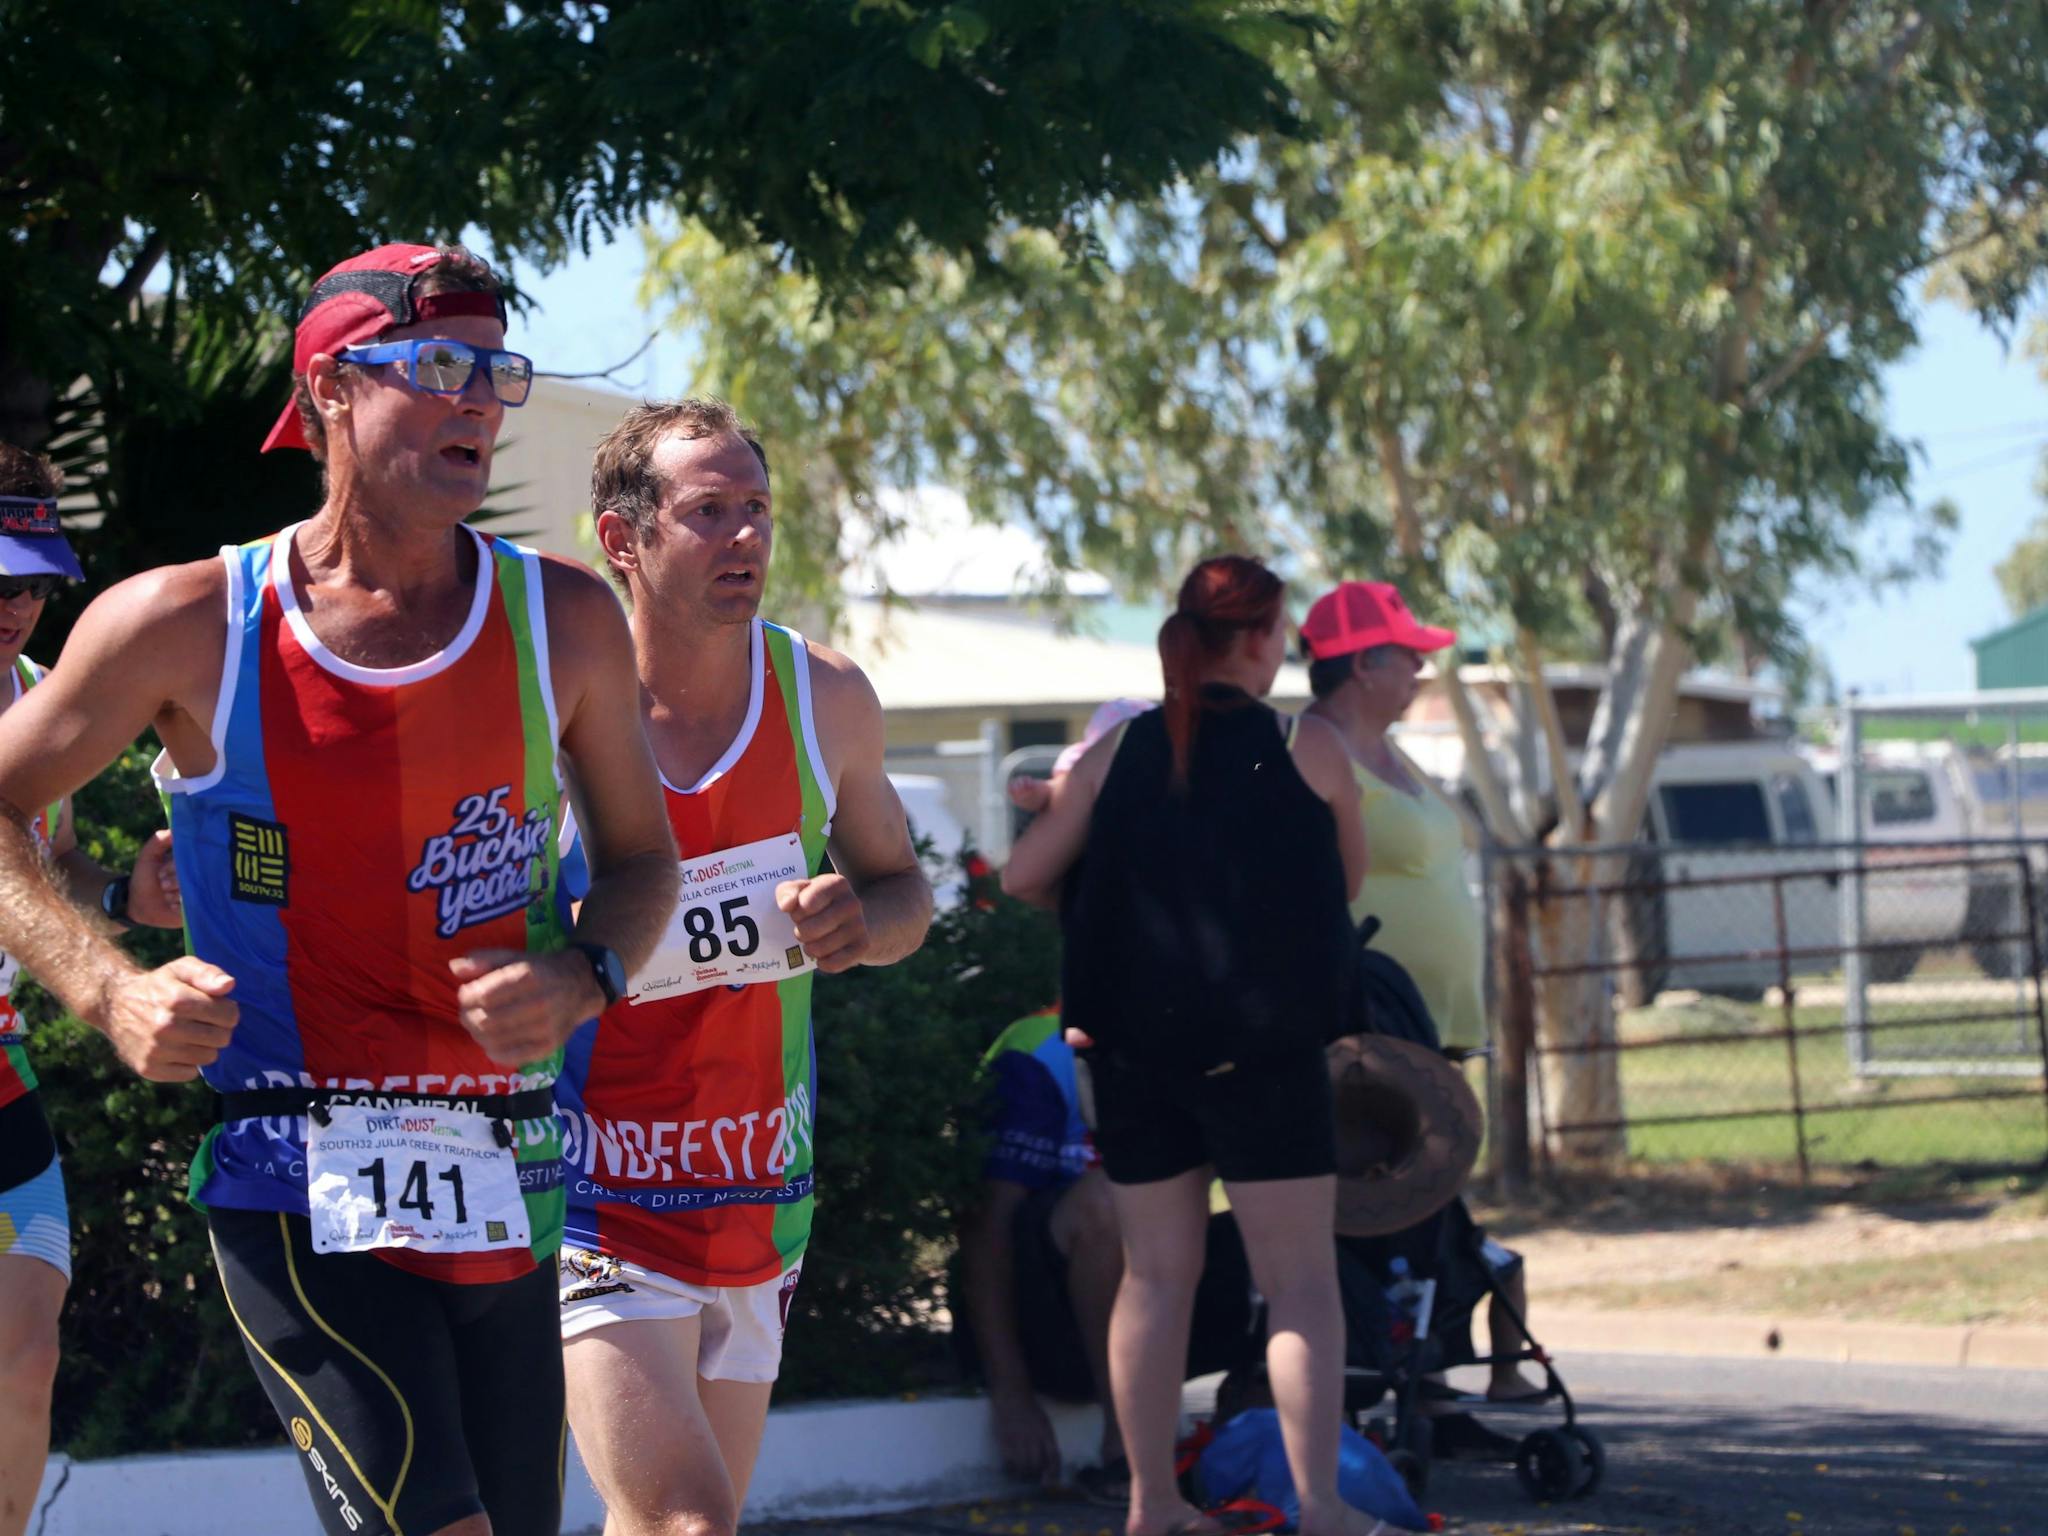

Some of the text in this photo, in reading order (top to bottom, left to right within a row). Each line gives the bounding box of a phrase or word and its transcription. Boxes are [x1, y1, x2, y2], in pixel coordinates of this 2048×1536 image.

[455, 785, 511, 835] 25
[680, 866, 796, 903] ULIA CREEK TRIATHLON
[697, 861, 725, 882] DUST
[724, 859, 755, 876] FESTIVAL
[683, 896, 760, 964] 85
[366, 1116, 400, 1133] DIRT
[405, 1118, 436, 1132] DUST
[320, 1138, 500, 1159] SOUTH32 JULIA CREEK TRIATHLON
[358, 1157, 468, 1224] 141
[308, 1447, 363, 1531] SKINS
